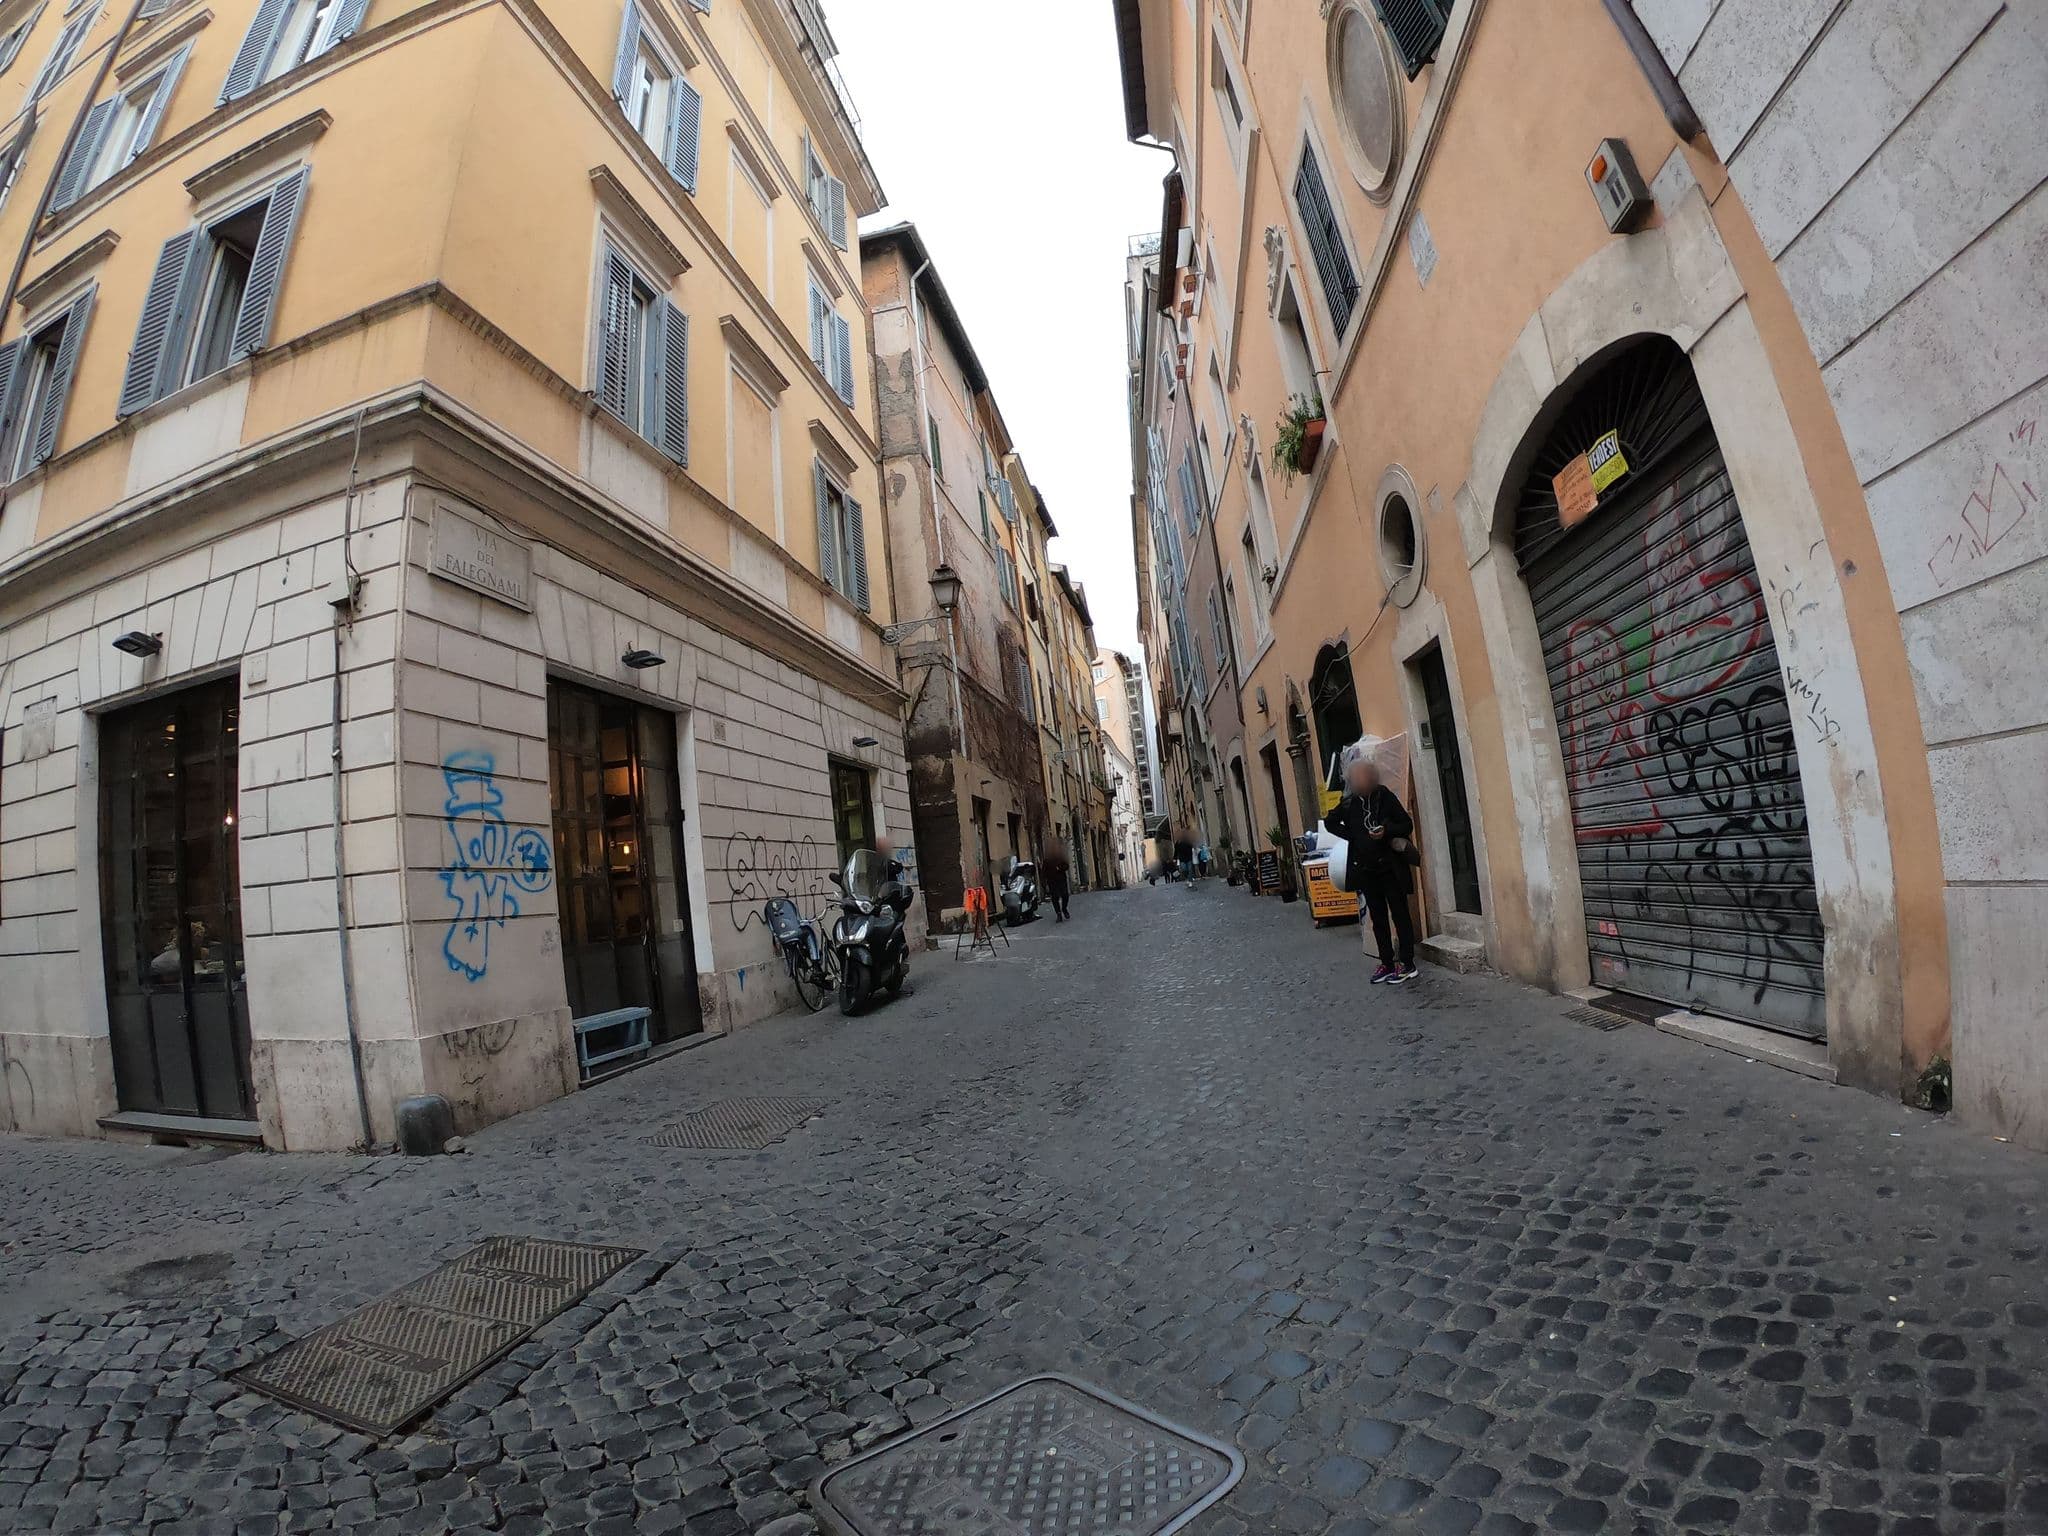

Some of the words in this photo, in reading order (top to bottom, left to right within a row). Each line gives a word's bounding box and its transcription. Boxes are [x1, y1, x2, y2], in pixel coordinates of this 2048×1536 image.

[473, 528, 498, 552] VIA
[476, 550, 494, 567] DEI
[445, 554, 521, 599] FALEGNAMI
